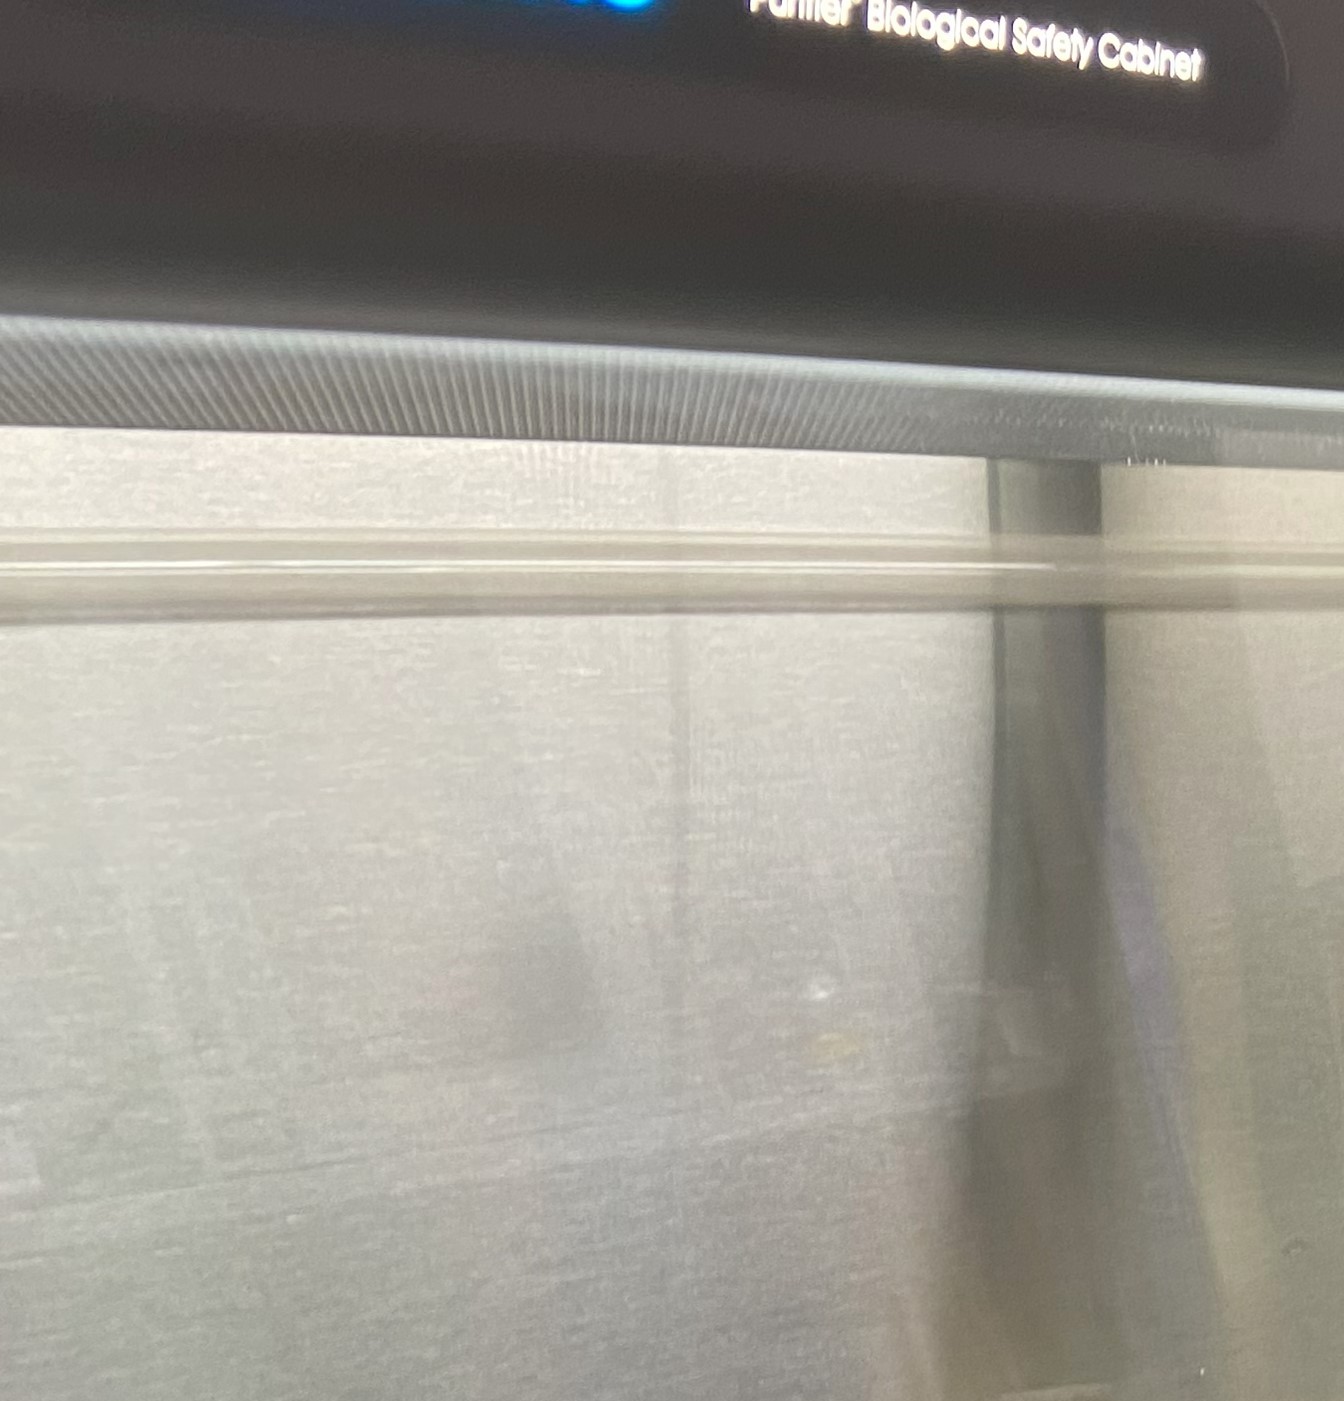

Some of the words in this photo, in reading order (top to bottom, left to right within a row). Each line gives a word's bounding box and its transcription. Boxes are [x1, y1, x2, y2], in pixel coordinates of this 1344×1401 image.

[867, 0, 1006, 50] Biological
[1012, 17, 1094, 70] Safety
[1098, 32, 1202, 81] Cabinet
